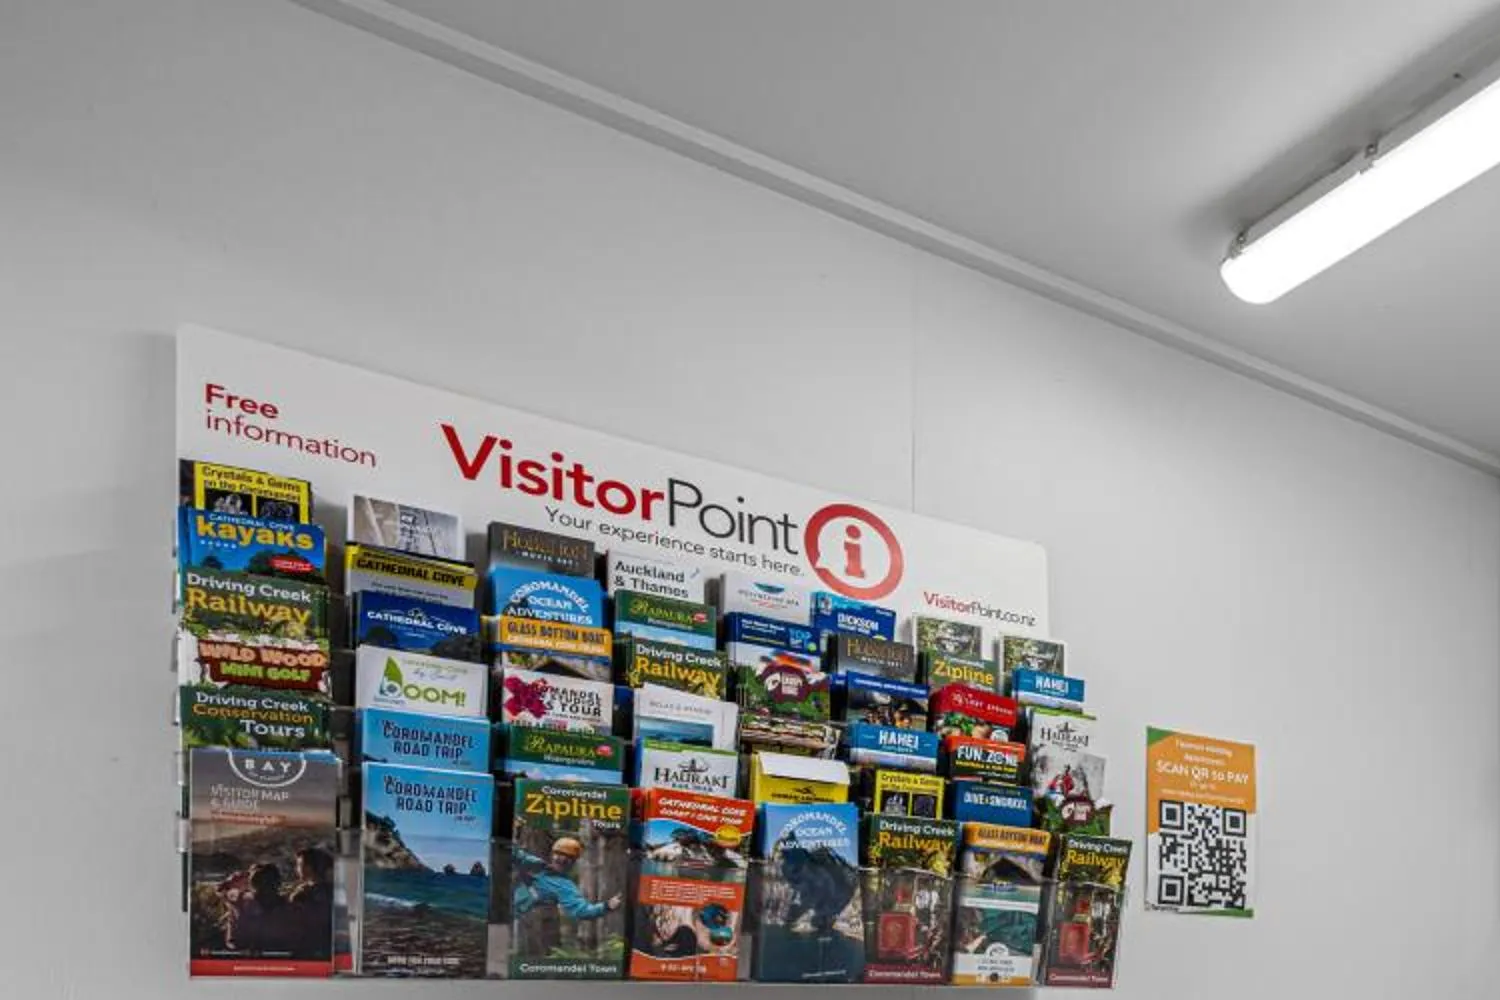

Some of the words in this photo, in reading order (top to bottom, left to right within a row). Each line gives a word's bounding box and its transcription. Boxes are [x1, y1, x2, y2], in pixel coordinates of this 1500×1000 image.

[205, 383, 278, 419] Free
[206, 409, 376, 467] information
[203, 465, 252, 482] Crystals
[268, 477, 301, 492] Gems
[442, 423, 798, 555] VisitorPoint
[545, 505, 593, 532] Your
[599, 521, 704, 556] experience
[709, 546, 757, 568] starts
[762, 554, 804, 576] here.
[615, 561, 685, 583] Auckland
[187, 572, 256, 596] Driving
[259, 584, 311, 603] Creek
[510, 580, 590, 613] COROMANDEL
[614, 575, 624, 586] &
[629, 577, 689, 598] Thames
[187, 587, 311, 626] Railway
[527, 596, 573, 611] OCEAN
[367, 611, 434, 629] CATHEDRAL
[437, 621, 468, 635] COVE
[636, 644, 682, 662] Driving
[686, 653, 721, 668] Creek
[635, 656, 720, 684] Railway
[934, 660, 993, 685] Zipline
[196, 691, 257, 709] Driving
[261, 697, 310, 712] Creek
[192, 704, 314, 724] Conservation
[240, 719, 305, 738] Tours
[383, 725, 475, 749] COROMANDEL
[394, 741, 429, 757] ROAD
[435, 745, 463, 760] TRIP
[957, 745, 981, 761] FUN
[1156, 760, 1189, 776] SCAN
[1191, 765, 1209, 779] QR
[1227, 771, 1249, 784] PAY
[385, 781, 477, 803] COROMANDEL
[396, 797, 433, 813] ROAD
[439, 801, 467, 815] TRIP
[525, 794, 622, 820] Zipline
[880, 820, 920, 834] Driving
[923, 825, 955, 836] Creek
[879, 832, 952, 853] Railway
[1068, 839, 1102, 851] Driving
[1067, 850, 1125, 868] Railway
[519, 963, 587, 974] Coromandel
